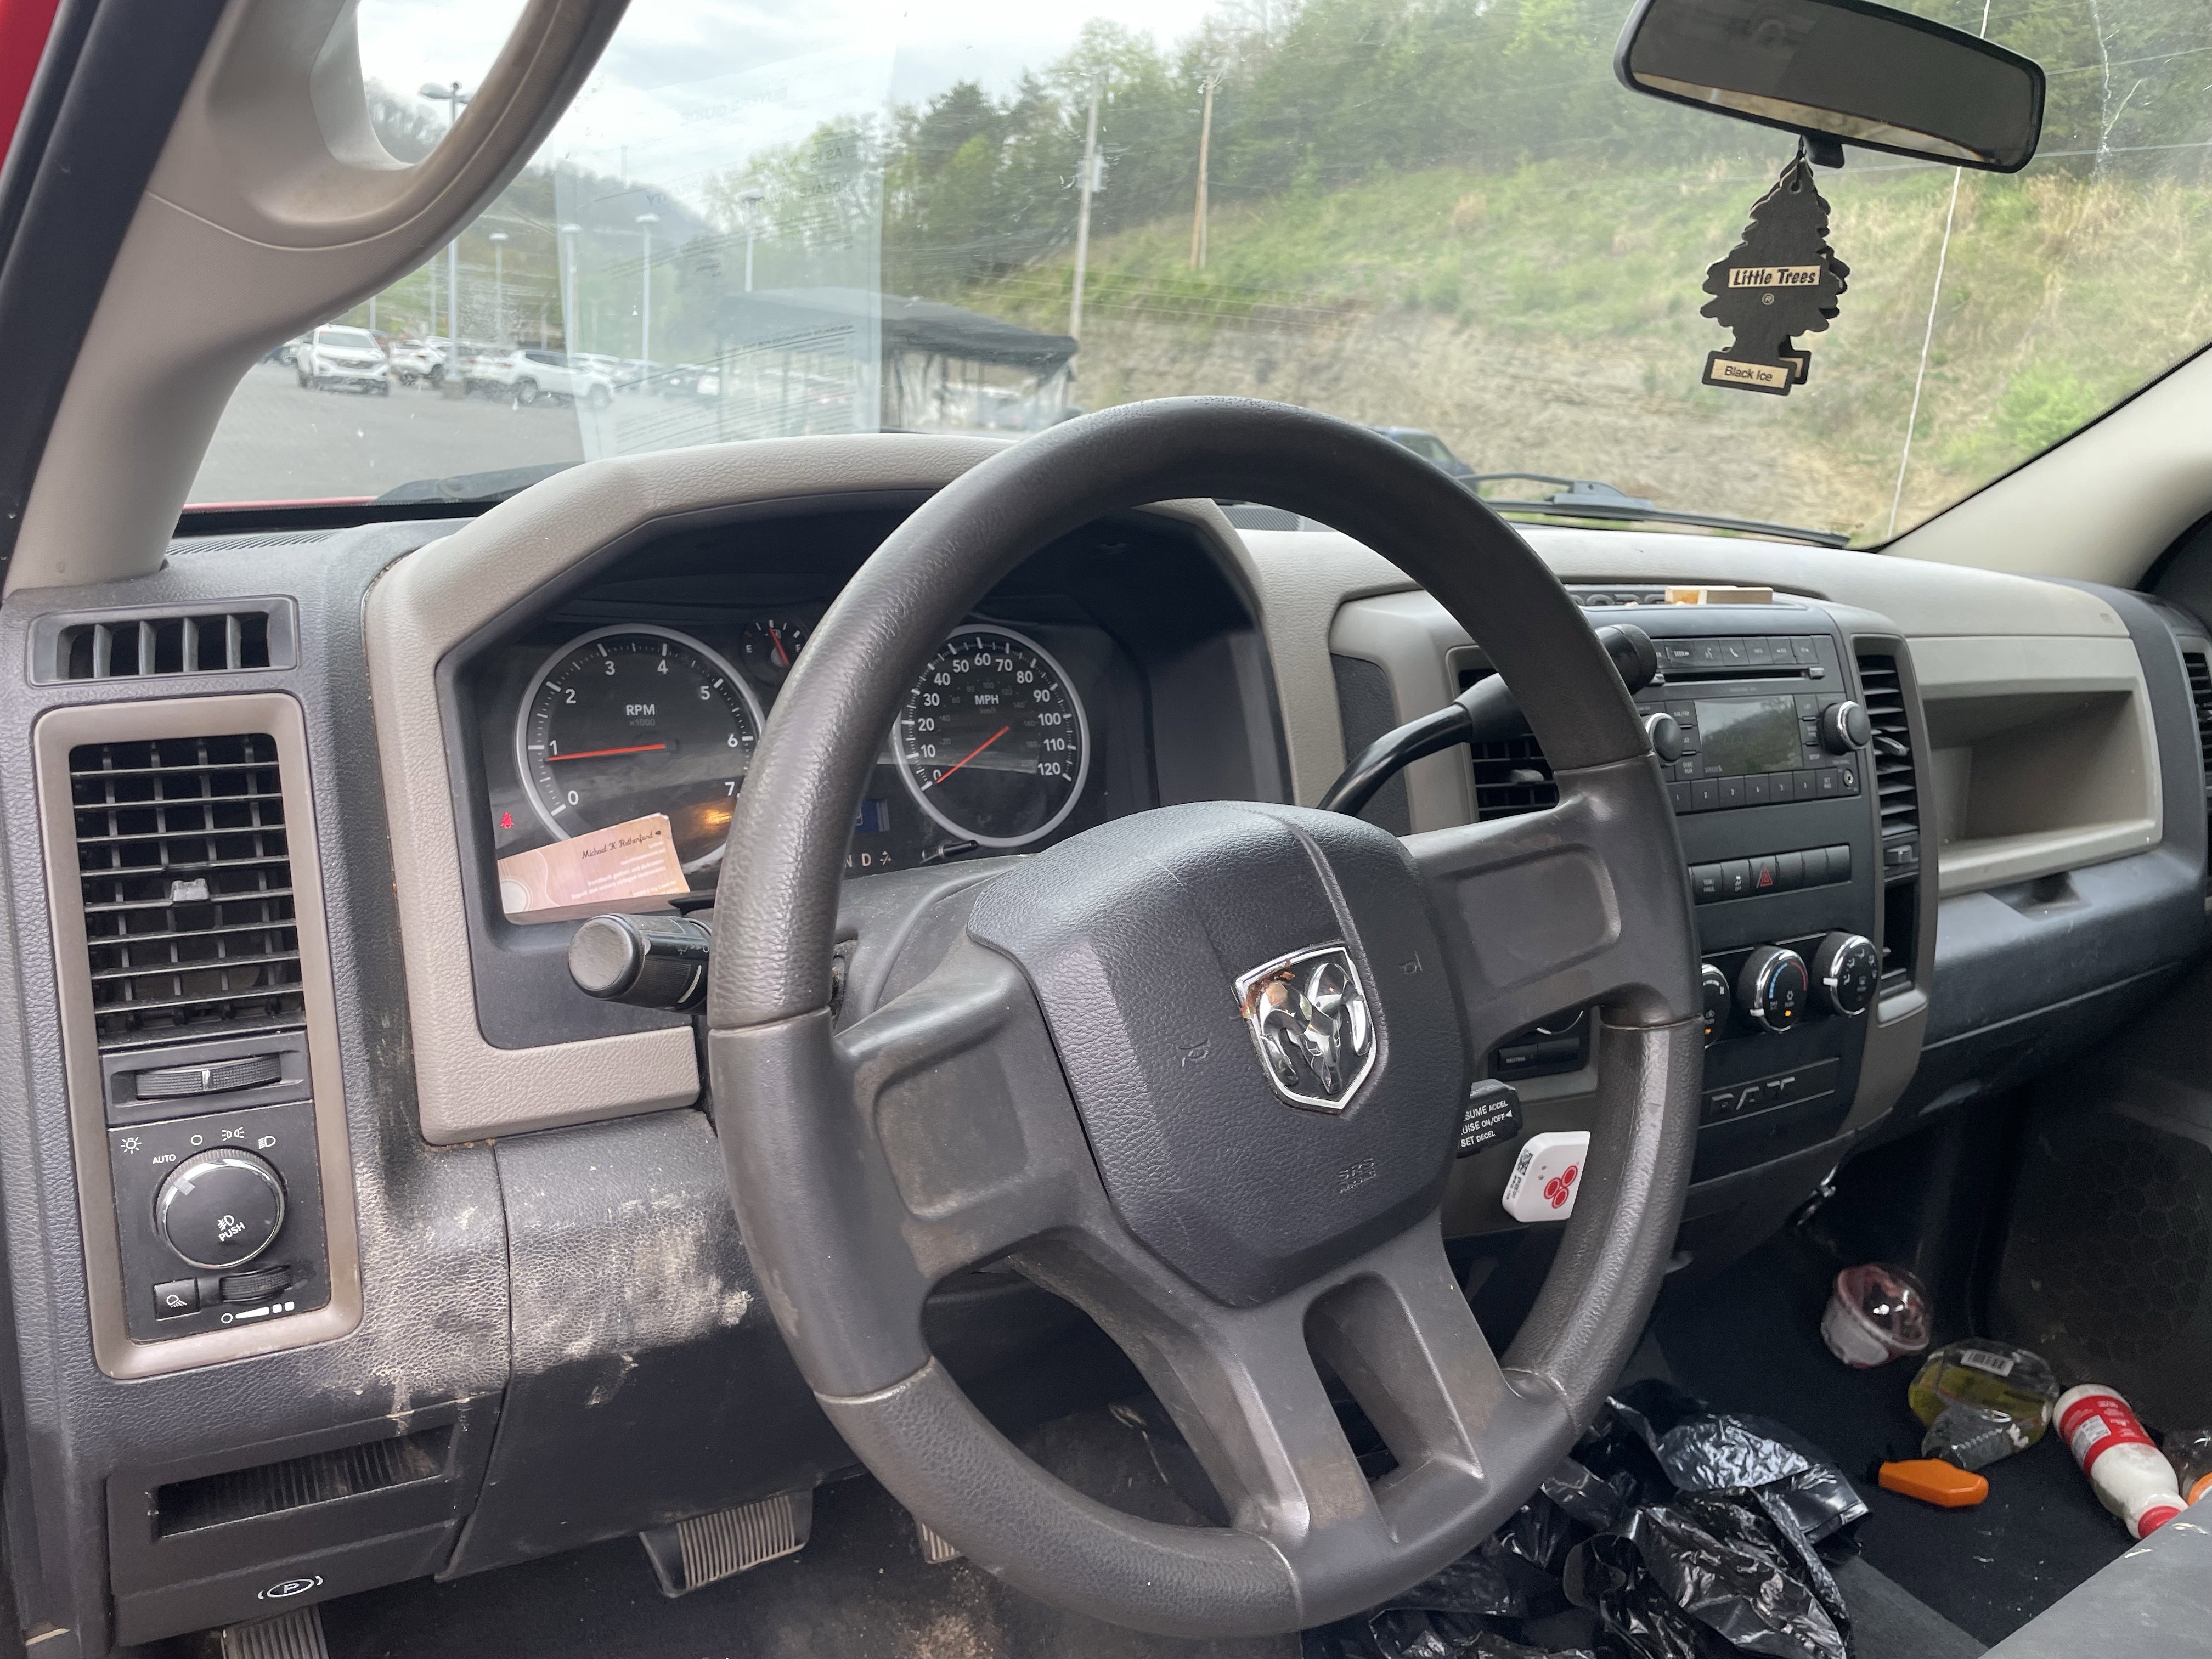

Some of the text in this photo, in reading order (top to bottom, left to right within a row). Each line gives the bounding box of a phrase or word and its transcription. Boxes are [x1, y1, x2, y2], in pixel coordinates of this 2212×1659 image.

[1734, 268, 1816, 285] Little Trees
[1725, 366, 1773, 382] Black Ice
[746, 644, 752, 653] E
[658, 659, 669, 674] 4
[952, 659, 970, 673] 50
[974, 653, 991, 666] 60
[995, 659, 1013, 672] 70
[605, 661, 616, 675] 3
[933, 673, 951, 686] 40
[1017, 670, 1034, 684] 80
[565, 689, 577, 704] 2
[700, 685, 710, 701] 5
[923, 693, 940, 706] 30
[974, 694, 1000, 705] MPH
[1033, 689, 1051, 703] 90
[625, 704, 656, 716] RPM
[917, 718, 935, 731] 20
[1037, 713, 1062, 726] 100
[549, 740, 558, 754] 1
[727, 734, 738, 747] 6
[1043, 738, 1065, 752] 110
[921, 744, 936, 758] 10
[933, 769, 942, 781] 0
[1037, 762, 1062, 776] 120
[725, 782, 736, 796] 7
[567, 791, 579, 805] 0
[582, 844, 608, 859] Michael
[609, 842, 616, 850] K
[619, 832, 653, 848] Rutherford
[861, 853, 872, 867] D
[1488, 1099, 1509, 1112] ACCEL
[1481, 1113, 1505, 1127] ON/OFF
[1460, 1130, 1496, 1148] SET DECEL
[153, 1154, 176, 1164] AUTO
[218, 1222, 246, 1242] PUSH
